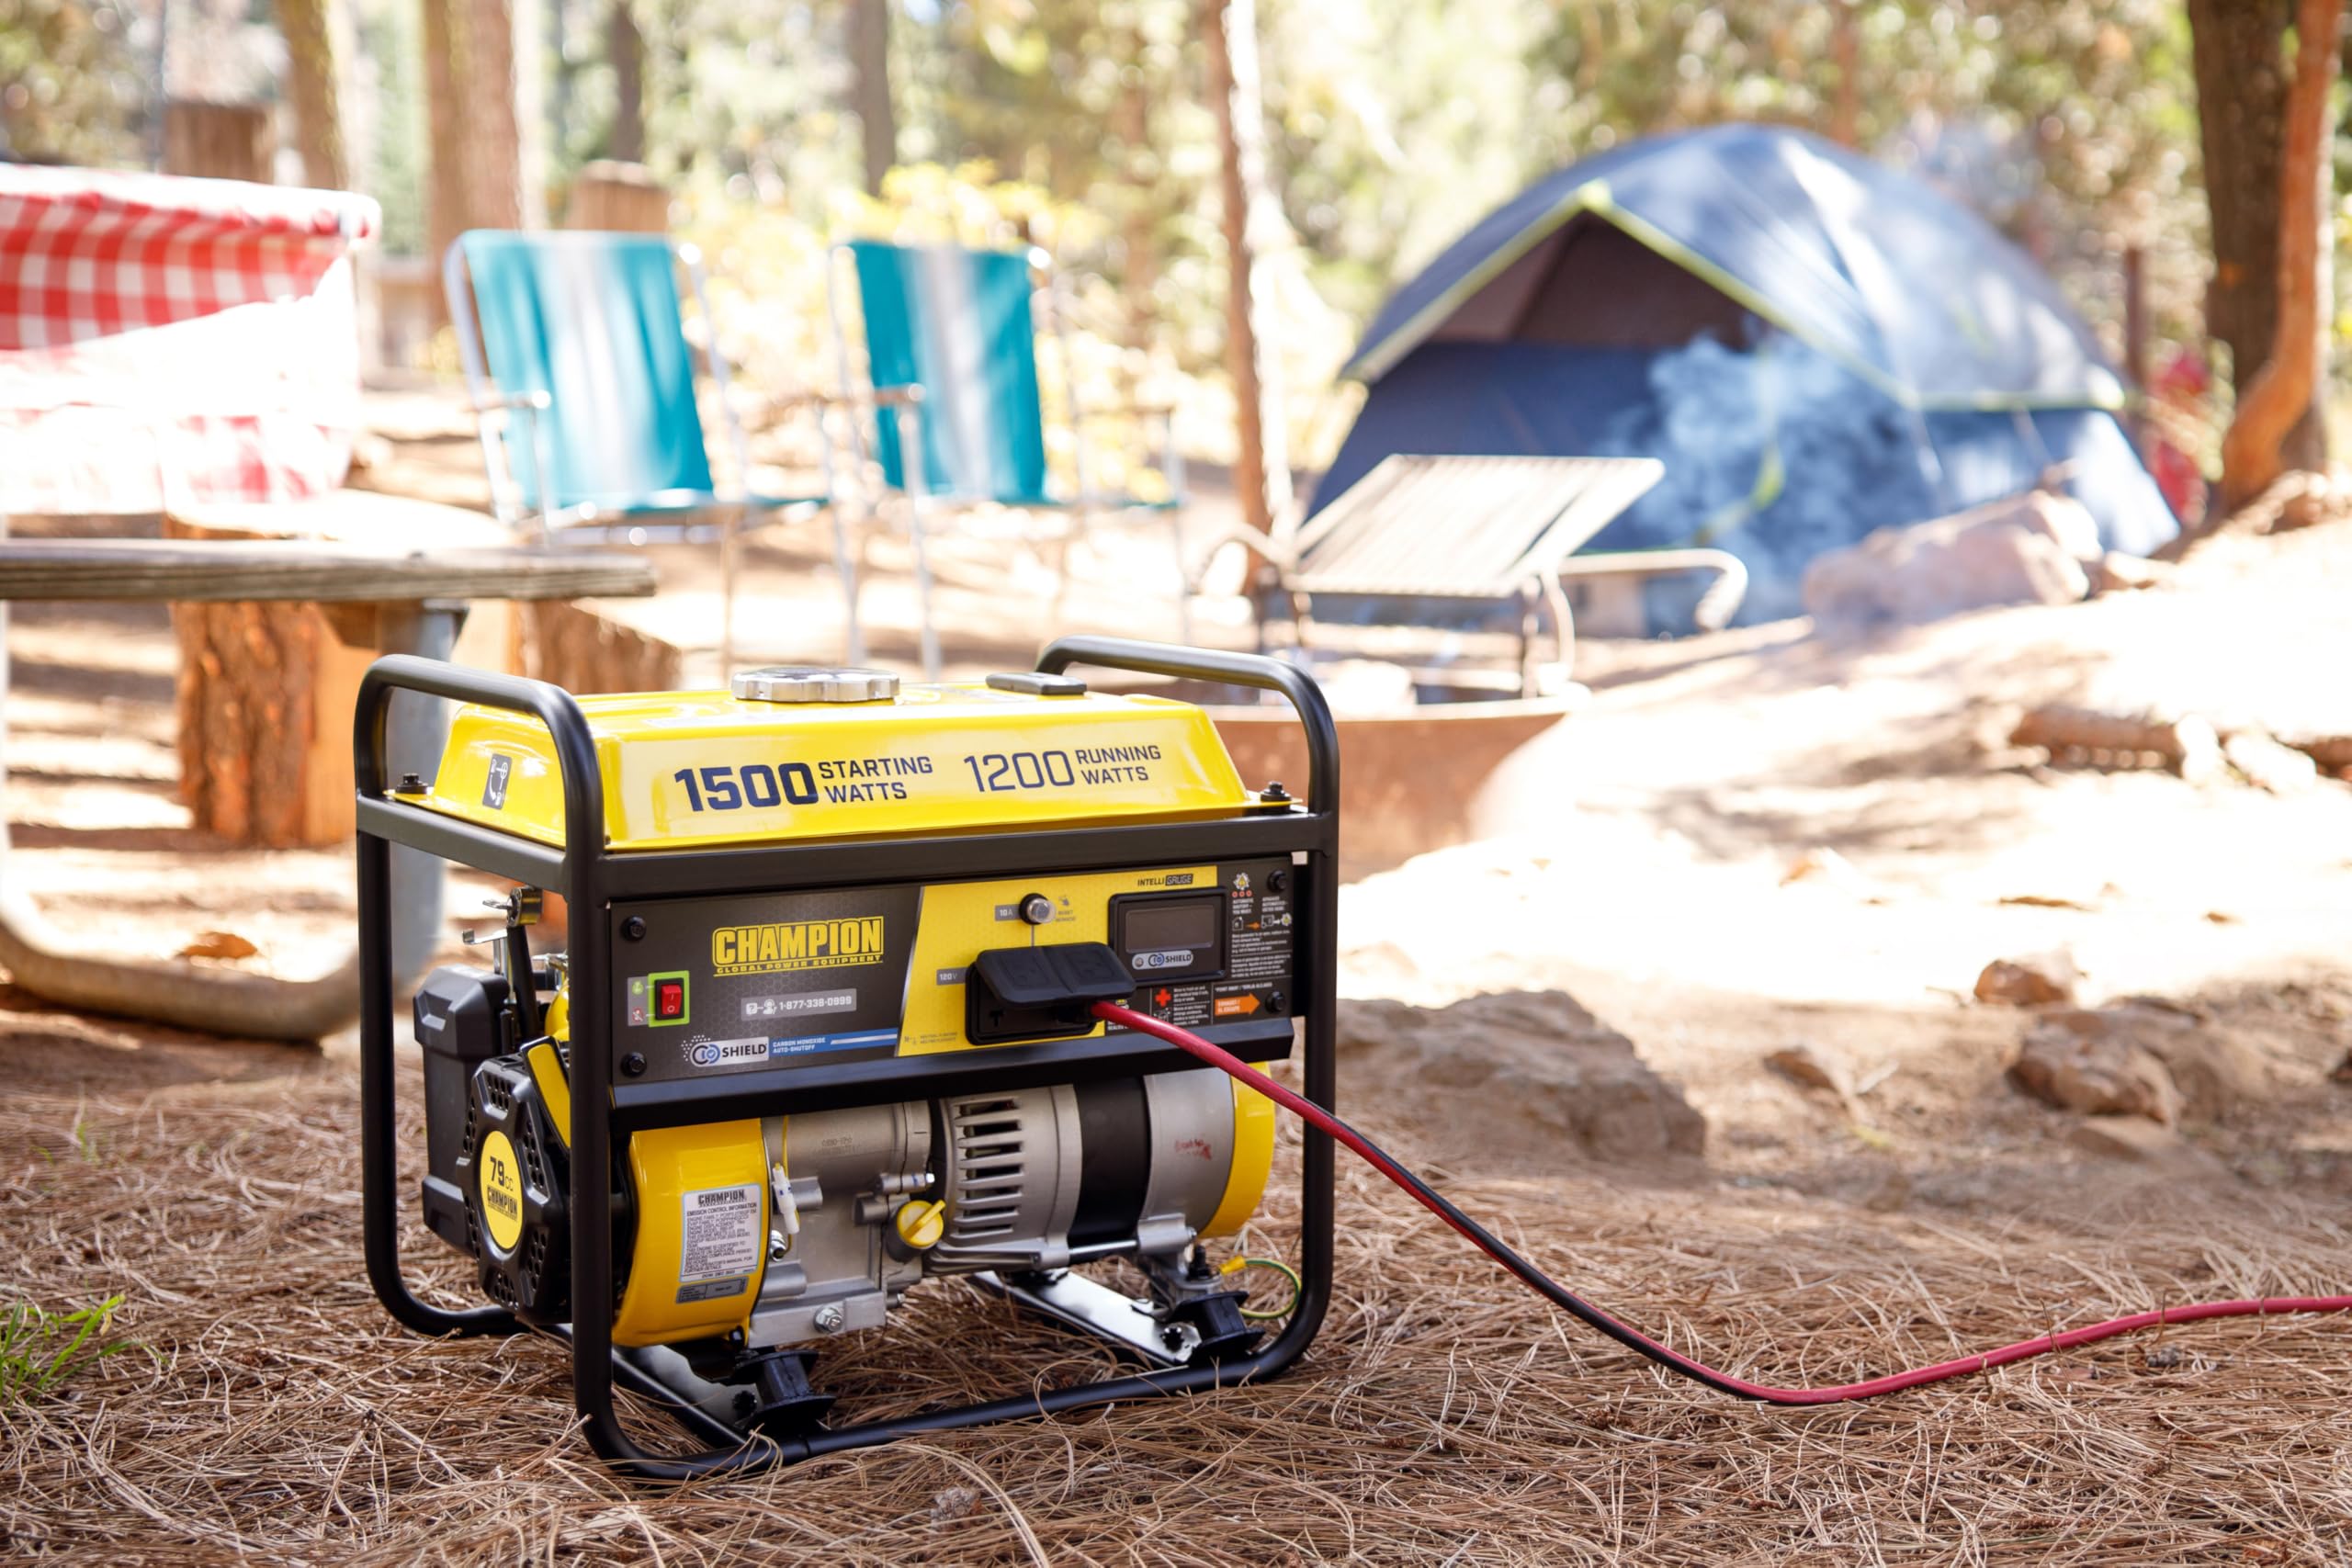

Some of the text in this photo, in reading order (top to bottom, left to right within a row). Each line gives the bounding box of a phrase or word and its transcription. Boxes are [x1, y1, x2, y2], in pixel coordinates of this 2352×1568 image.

[1076, 745, 1161, 764] RUNNING
[819, 756, 933, 779] STARTING
[963, 750, 1075, 792] 1200
[1080, 766, 1149, 784] WATTS
[674, 762, 820, 812] 1500
[824, 782, 907, 804] WATTS
[714, 918, 883, 965] CHAMPION
[717, 954, 882, 974] GLOBAL POWER EQUIPMENT
[1165, 954, 1192, 963] SHIELD
[722, 1043, 766, 1058] SHIELD
[773, 1040, 796, 1048] CARBON
[487, 1185, 518, 1215] CHAMPION
[698, 1190, 745, 1205] CHAMPION
